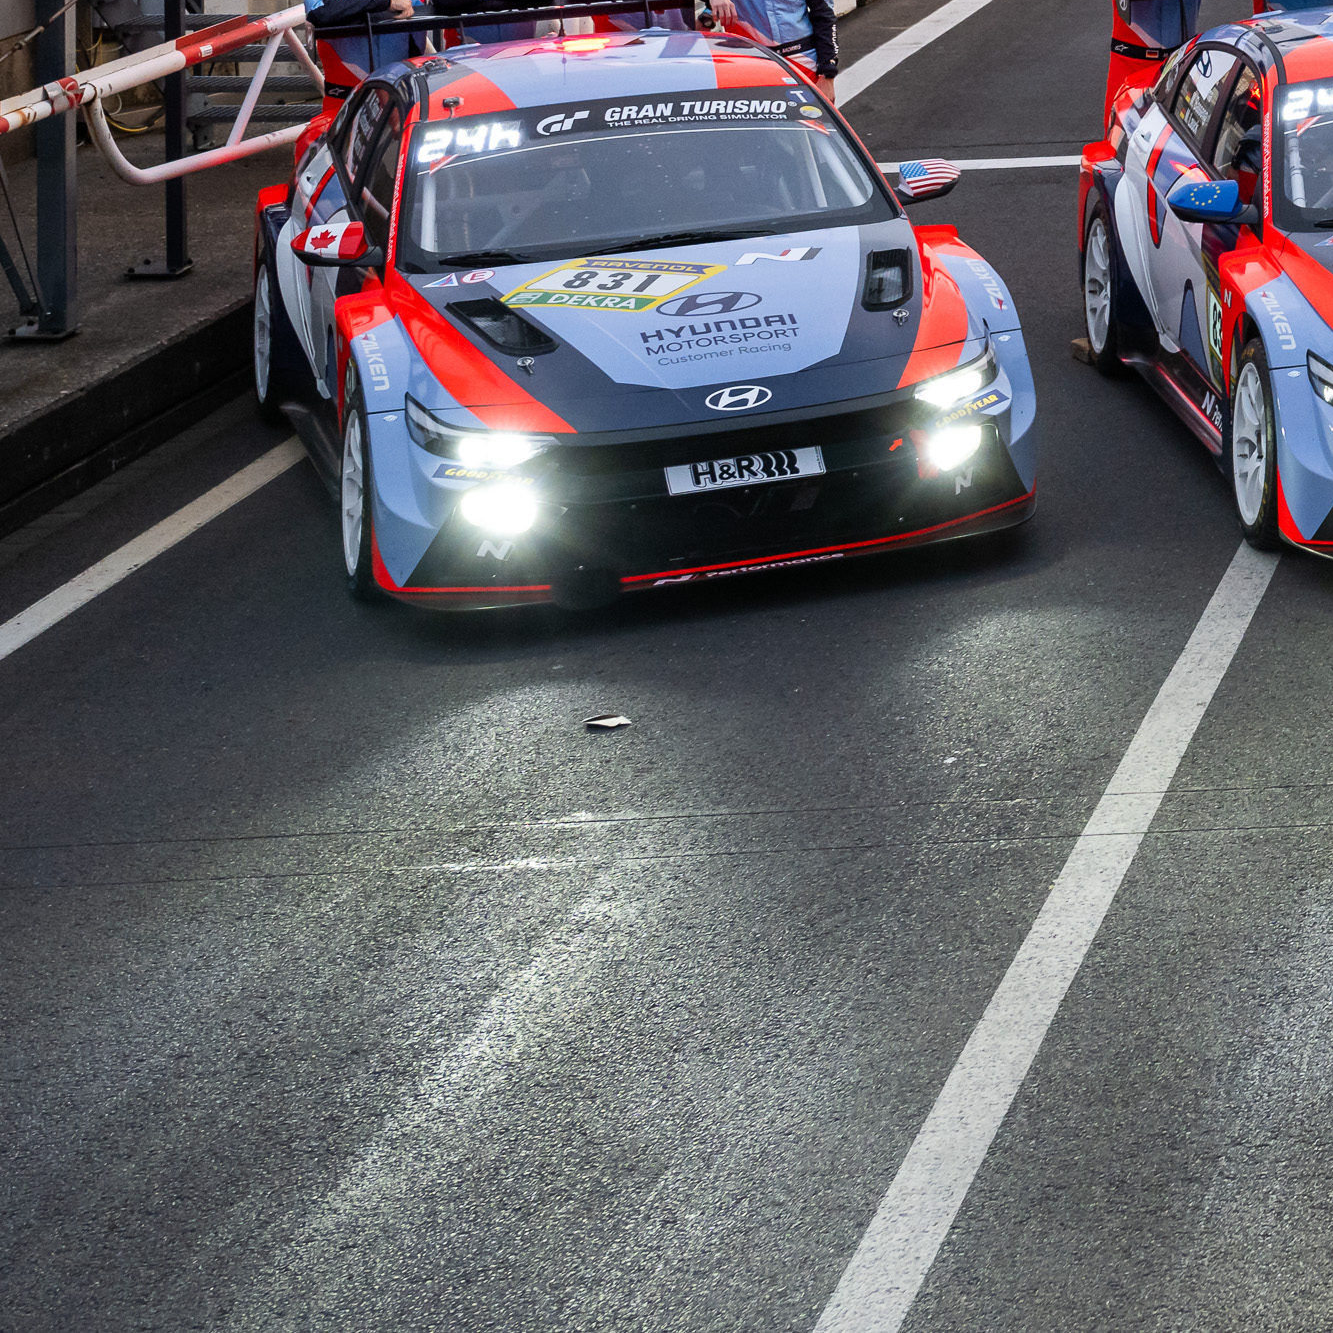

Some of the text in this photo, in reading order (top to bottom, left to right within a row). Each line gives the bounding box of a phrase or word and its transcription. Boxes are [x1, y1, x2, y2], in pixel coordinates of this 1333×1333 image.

[604, 99, 788, 122] GRAN TURISMO
[720, 113, 788, 122] SIMULATOR
[417, 118, 524, 163] 24h
[592, 259, 698, 273] RAVENOL
[563, 269, 663, 293] 831
[965, 258, 1008, 311] FALKEN
[547, 293, 637, 310] DEKRA
[640, 313, 798, 344] HYUNDAI
[1257, 291, 1297, 351] FALKEN
[646, 327, 800, 356] MOTORSPORT
[657, 343, 792, 366] Customer Racing
[360, 332, 390, 392] FALKEN
[691, 455, 759, 486] H&R
